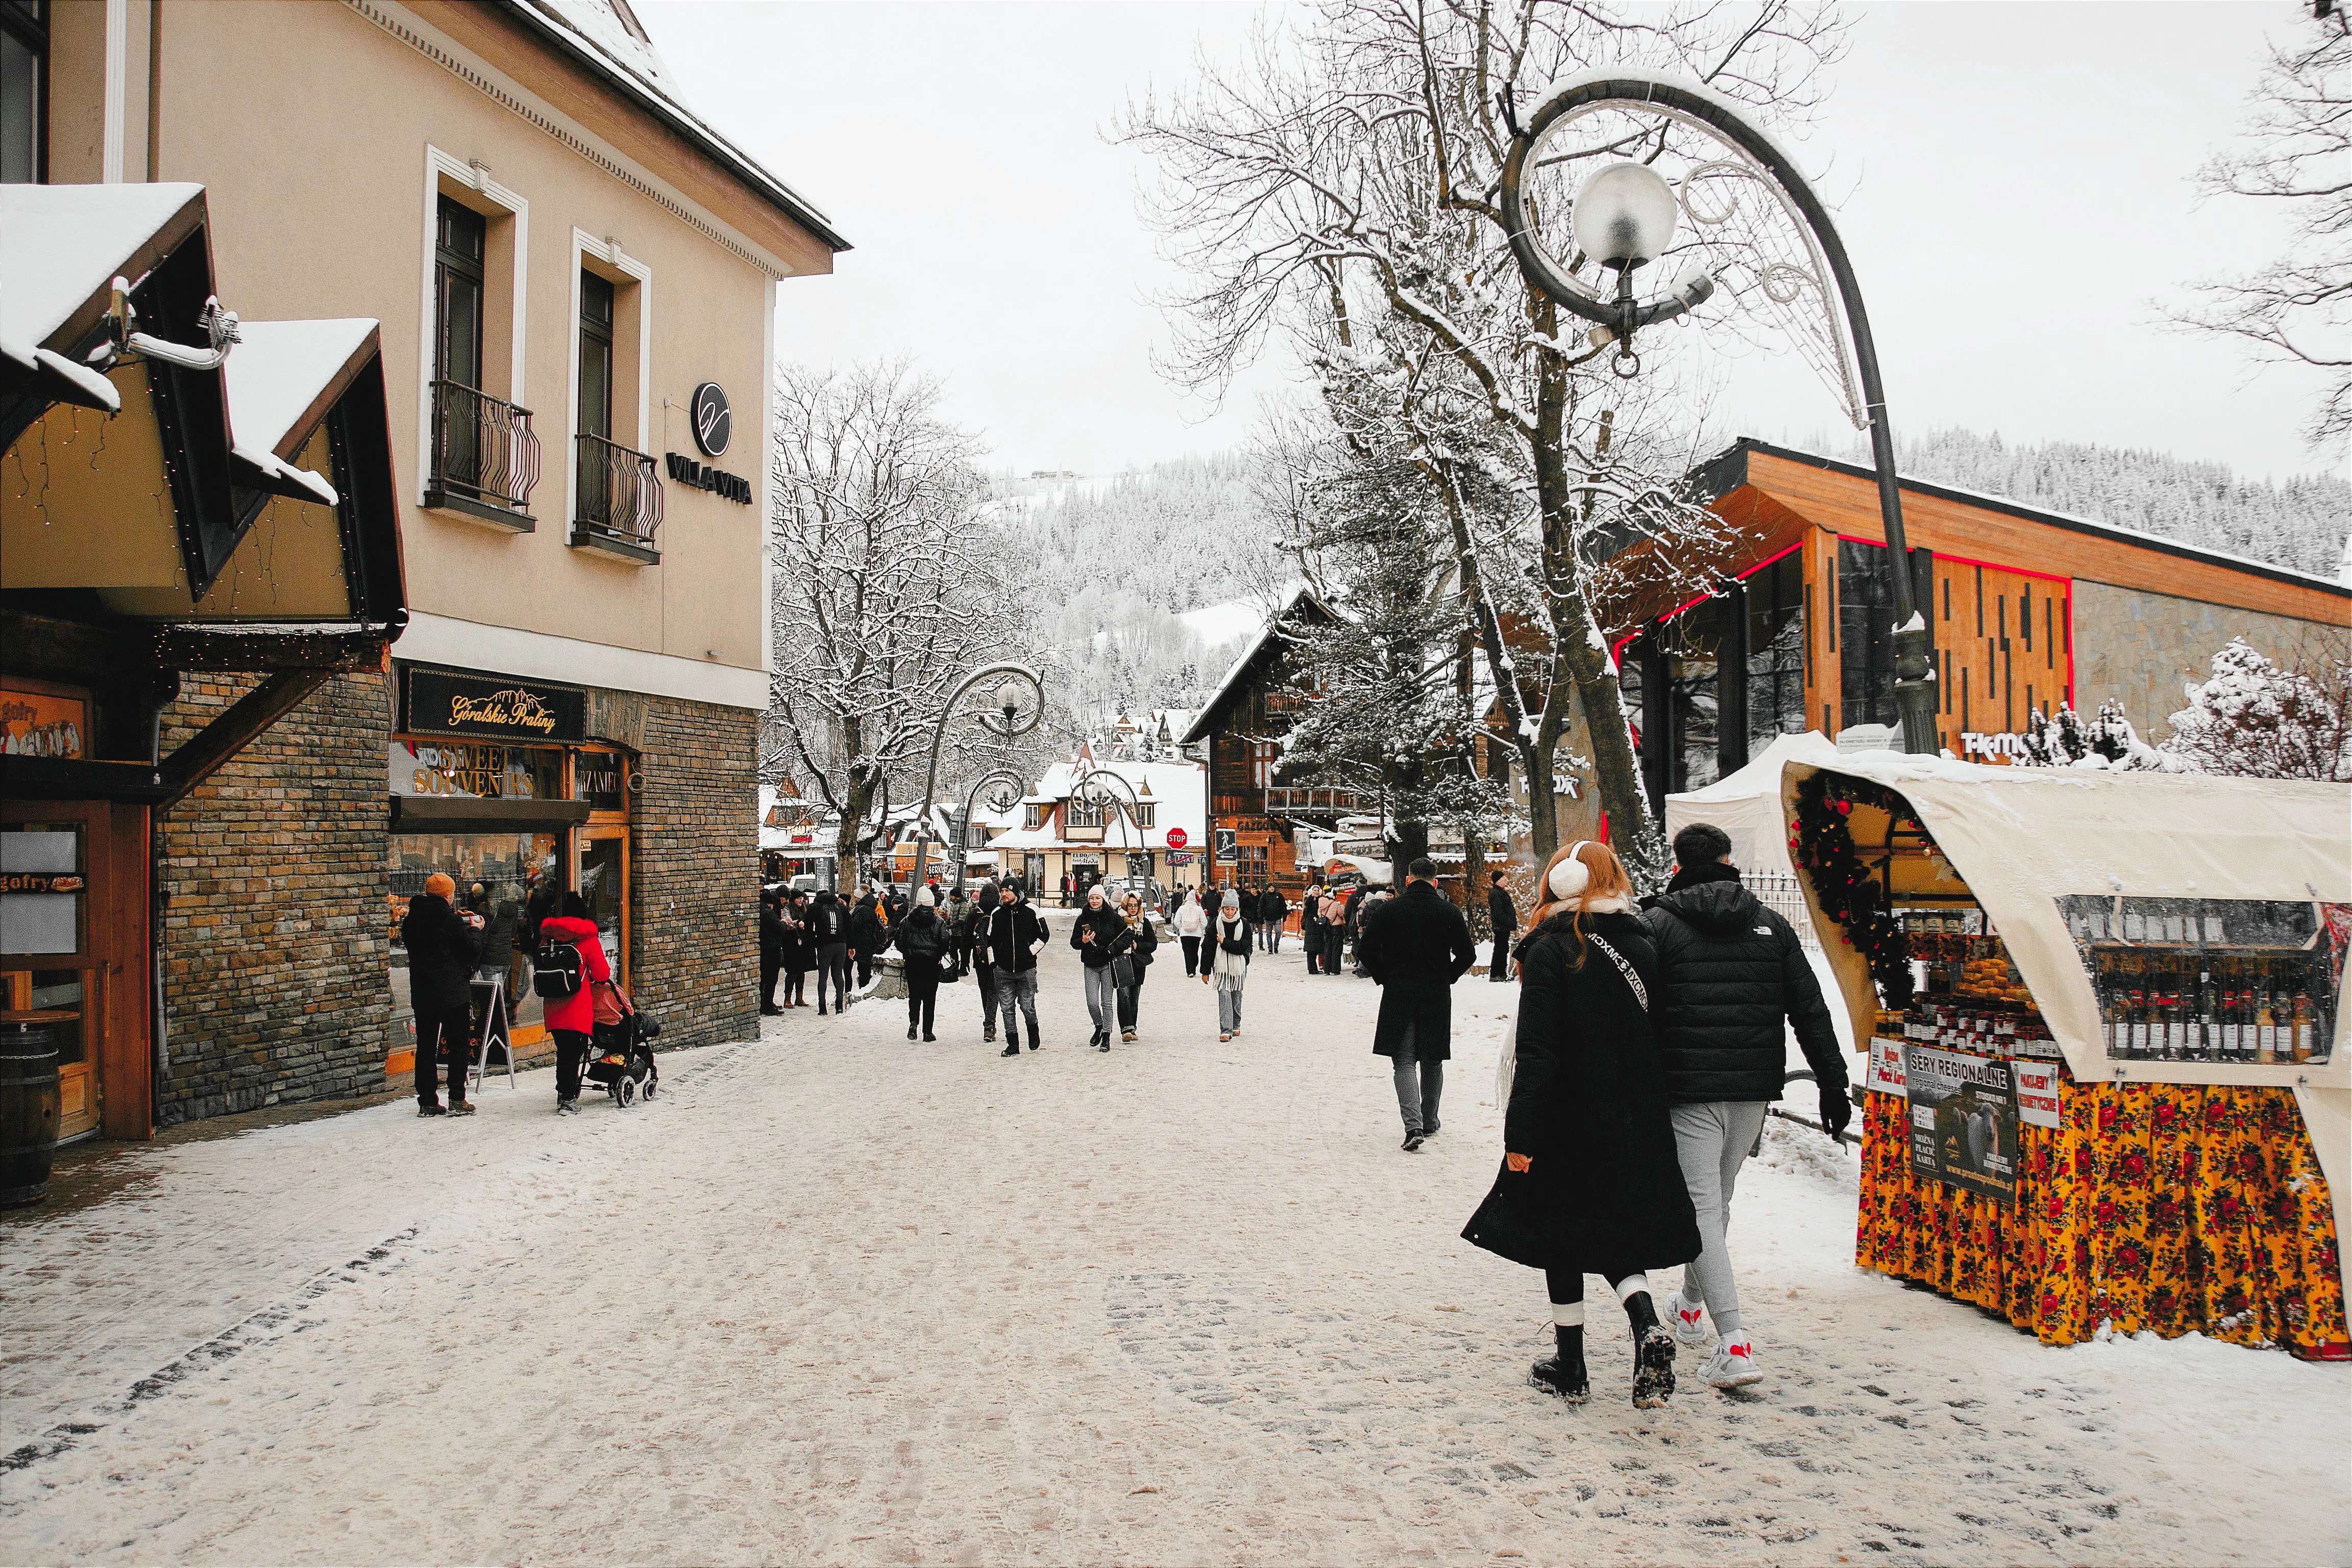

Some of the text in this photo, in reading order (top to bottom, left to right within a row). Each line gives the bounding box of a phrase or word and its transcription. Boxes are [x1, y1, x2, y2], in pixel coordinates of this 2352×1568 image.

[666, 452, 753, 504] VILLA VITA
[449, 695, 555, 734] Góralskie Praliny
[441, 744, 510, 770] SWEET
[415, 768, 534, 794] SOUVENIRS
[1168, 834, 1186, 842] STOP
[1177, 854, 1193, 863] TAXI
[0, 874, 50, 892] gofry
[1910, 1052, 2008, 1089] SERY REGIONALNE
[1913, 1077, 1963, 1096] regional cheeses
